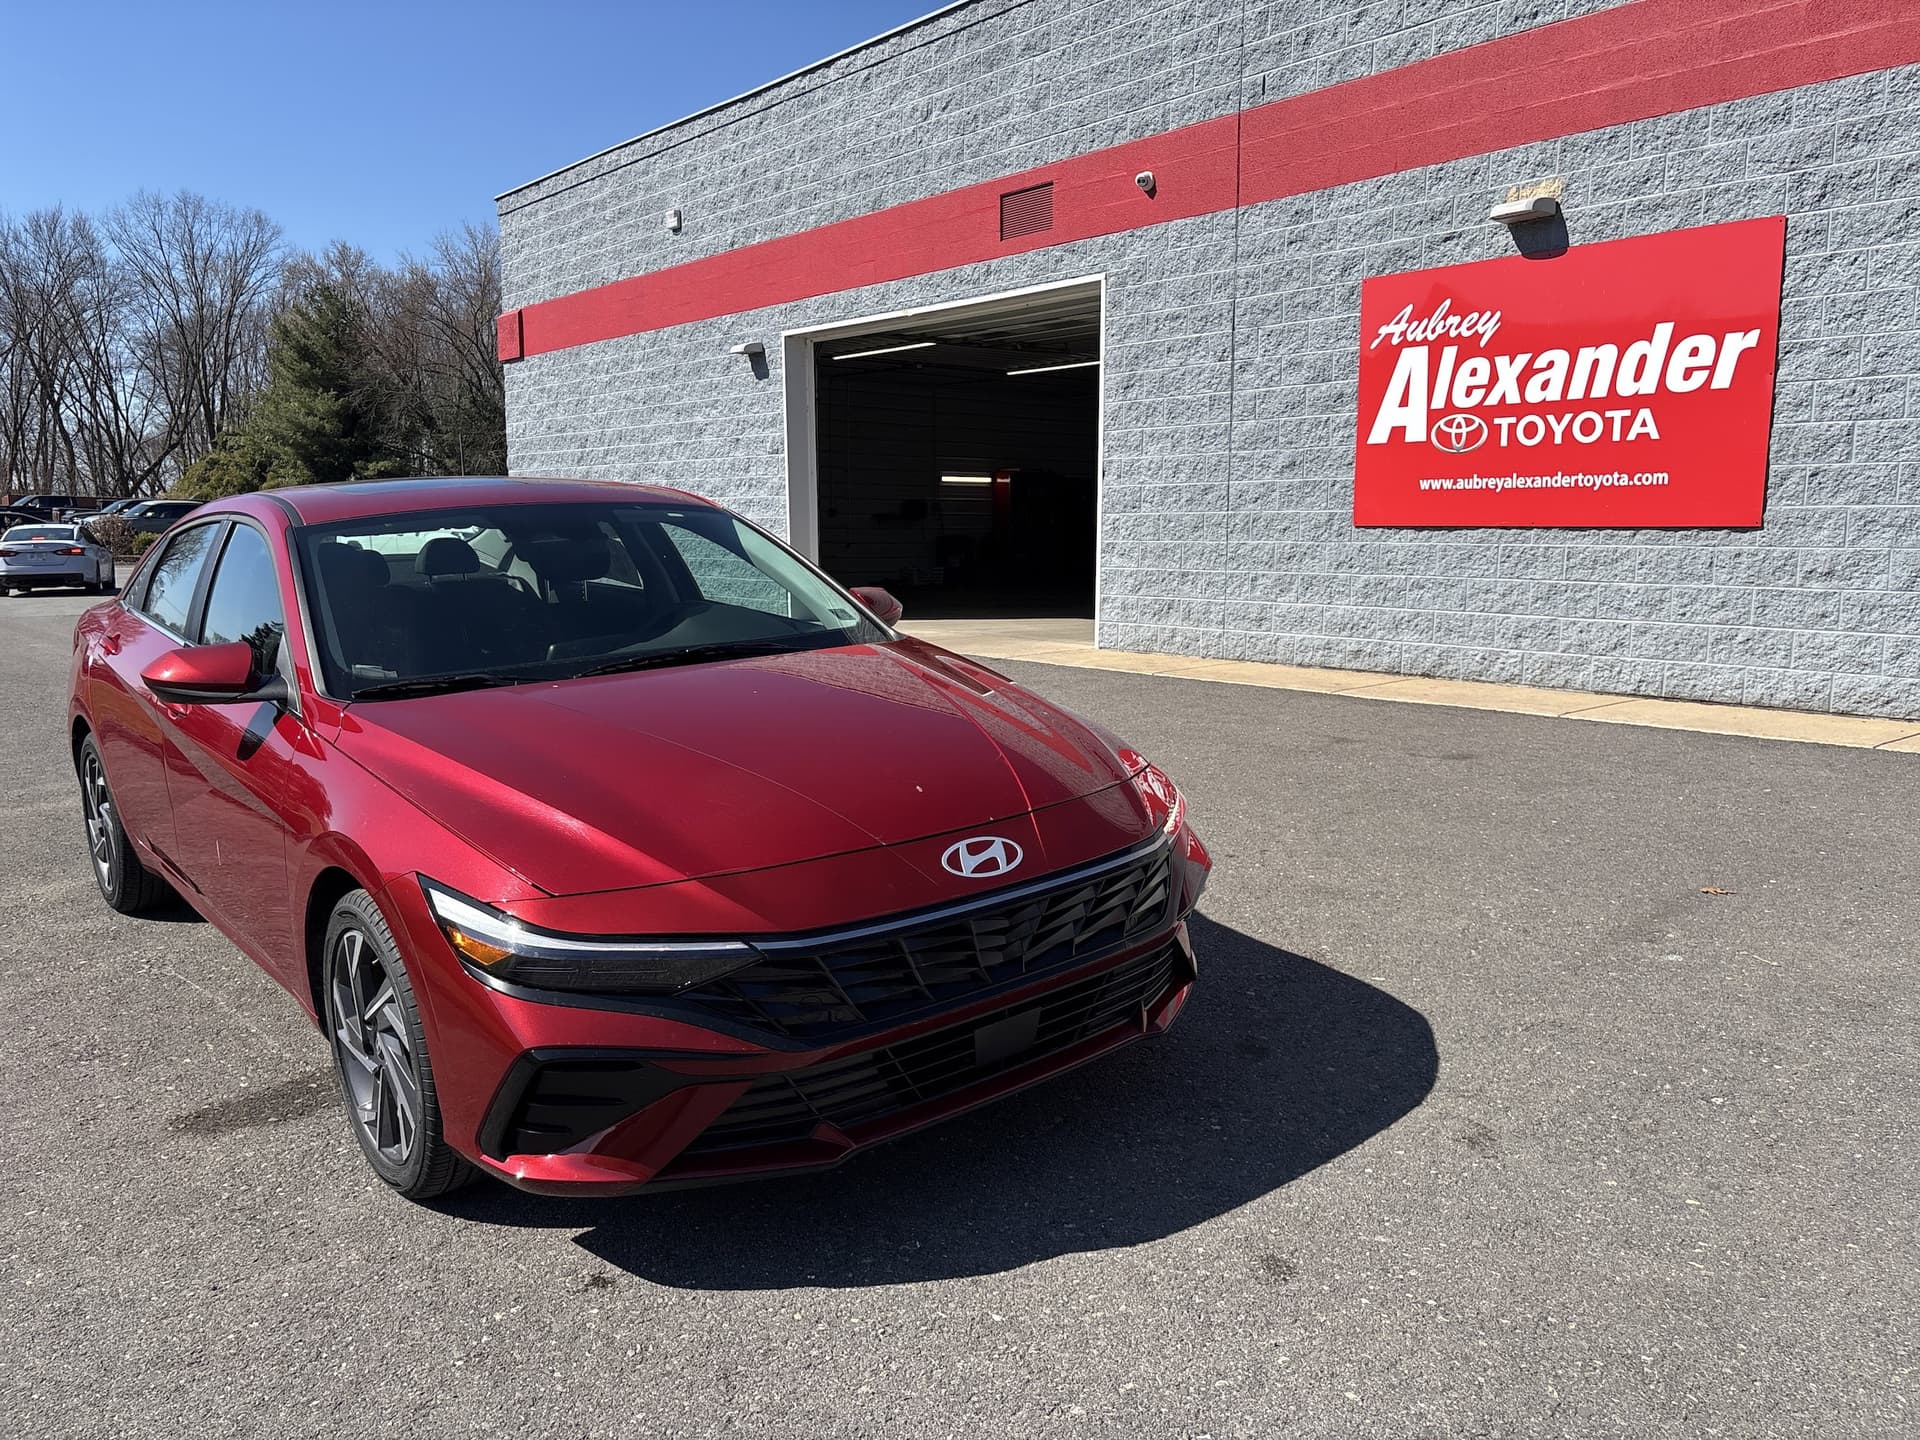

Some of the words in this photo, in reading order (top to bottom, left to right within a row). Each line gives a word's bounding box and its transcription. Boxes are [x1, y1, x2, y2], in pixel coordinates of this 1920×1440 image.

[1370, 298, 1502, 350] Aubrey
[1366, 322, 1761, 445] Alexander
[1493, 407, 1660, 447] TOYOTA
[1419, 471, 1669, 493] www.aubreyalexandertoyota.com
